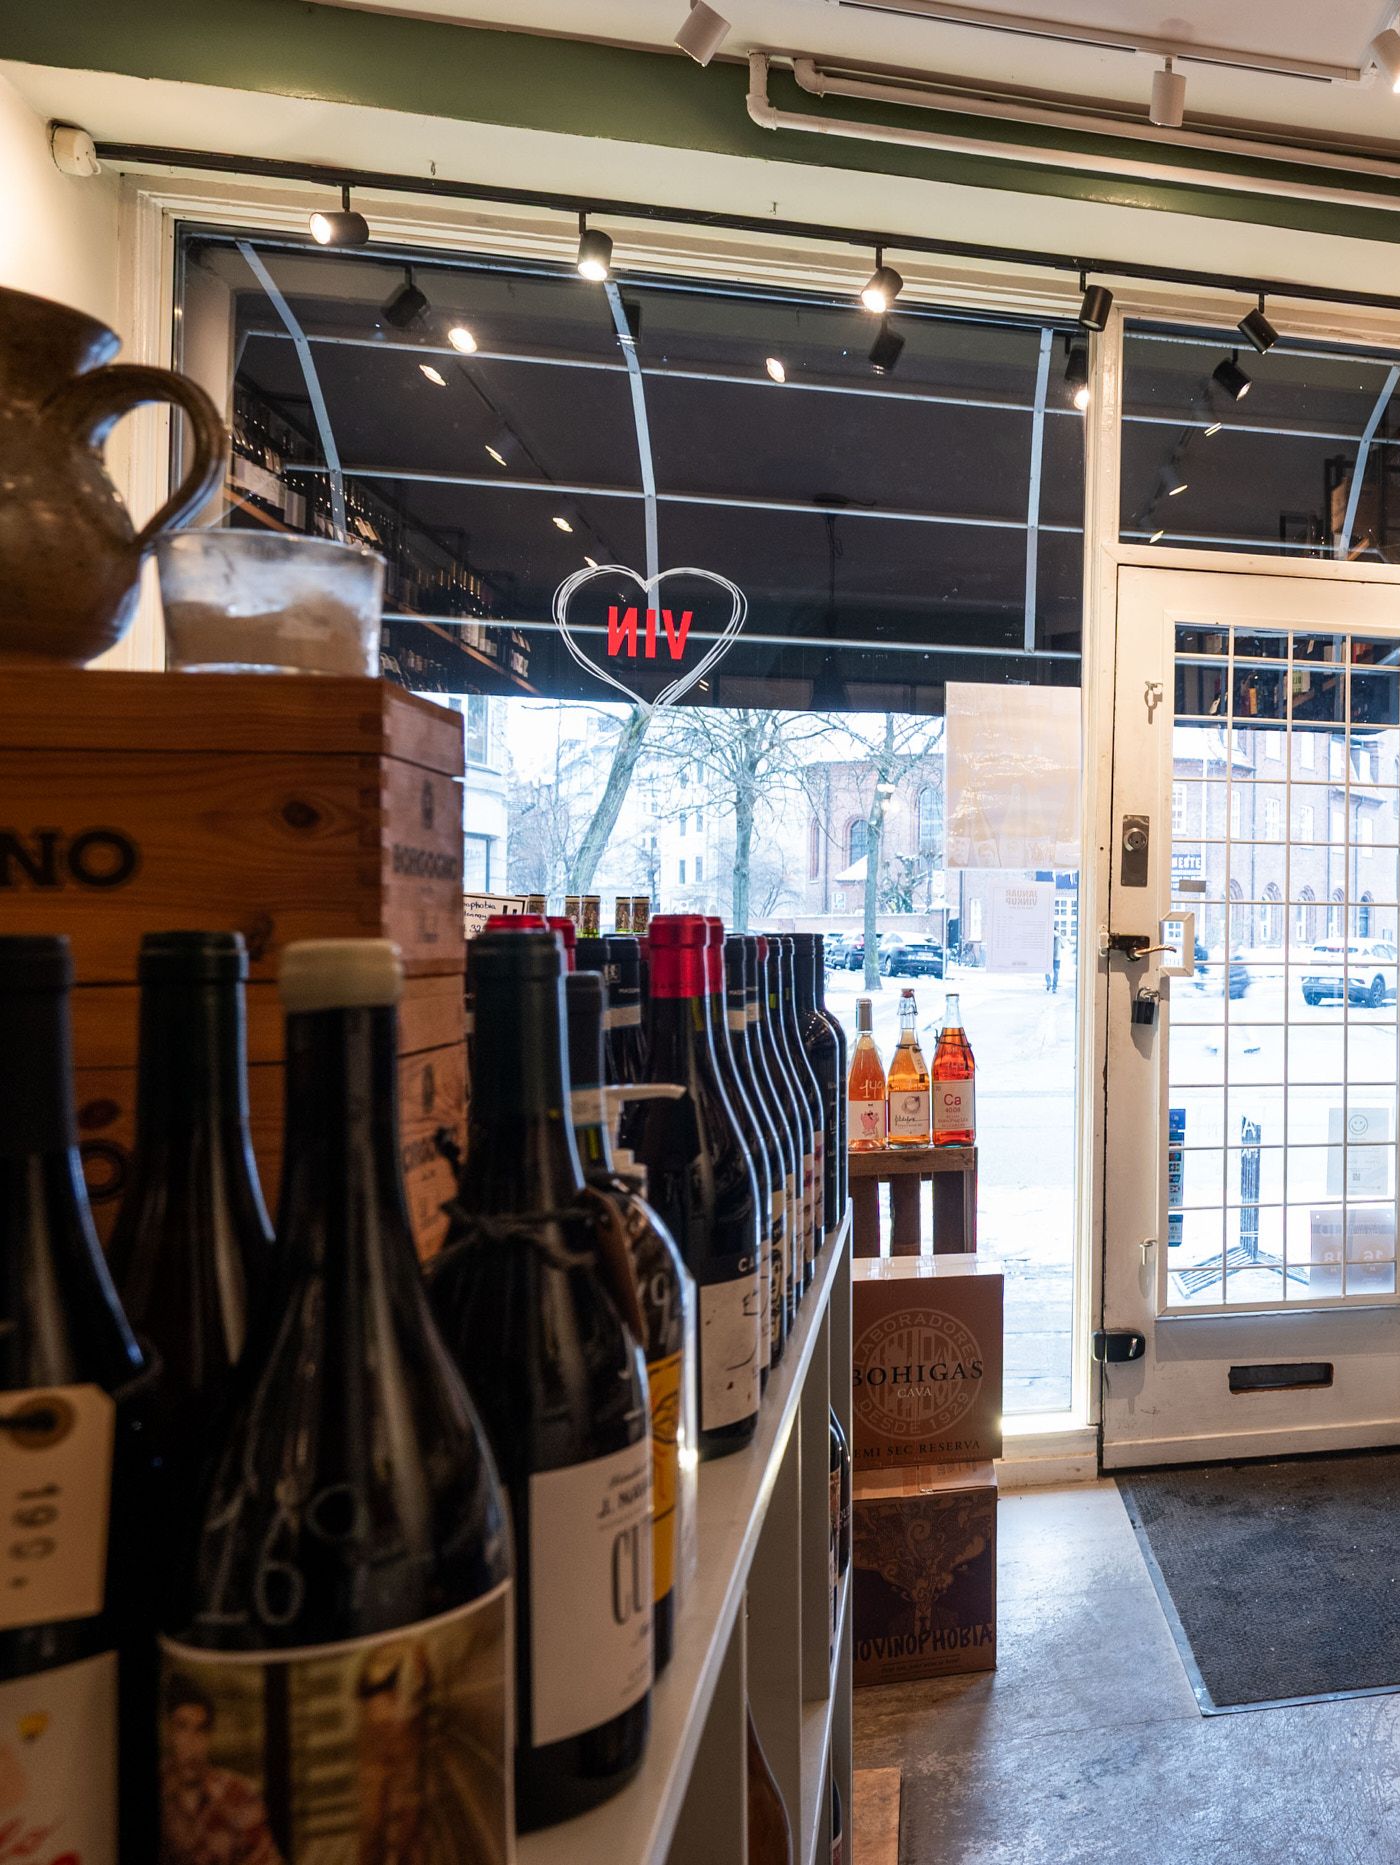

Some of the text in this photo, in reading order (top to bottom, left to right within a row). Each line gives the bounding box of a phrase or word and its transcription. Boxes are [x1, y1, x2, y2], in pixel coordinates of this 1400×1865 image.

[944, 1093, 961, 1106] Ca
[852, 1360, 983, 1387] BOHIGAS
[897, 1387, 932, 1399] CAVA
[854, 1440, 980, 1459] EMI SEC RESERVA
